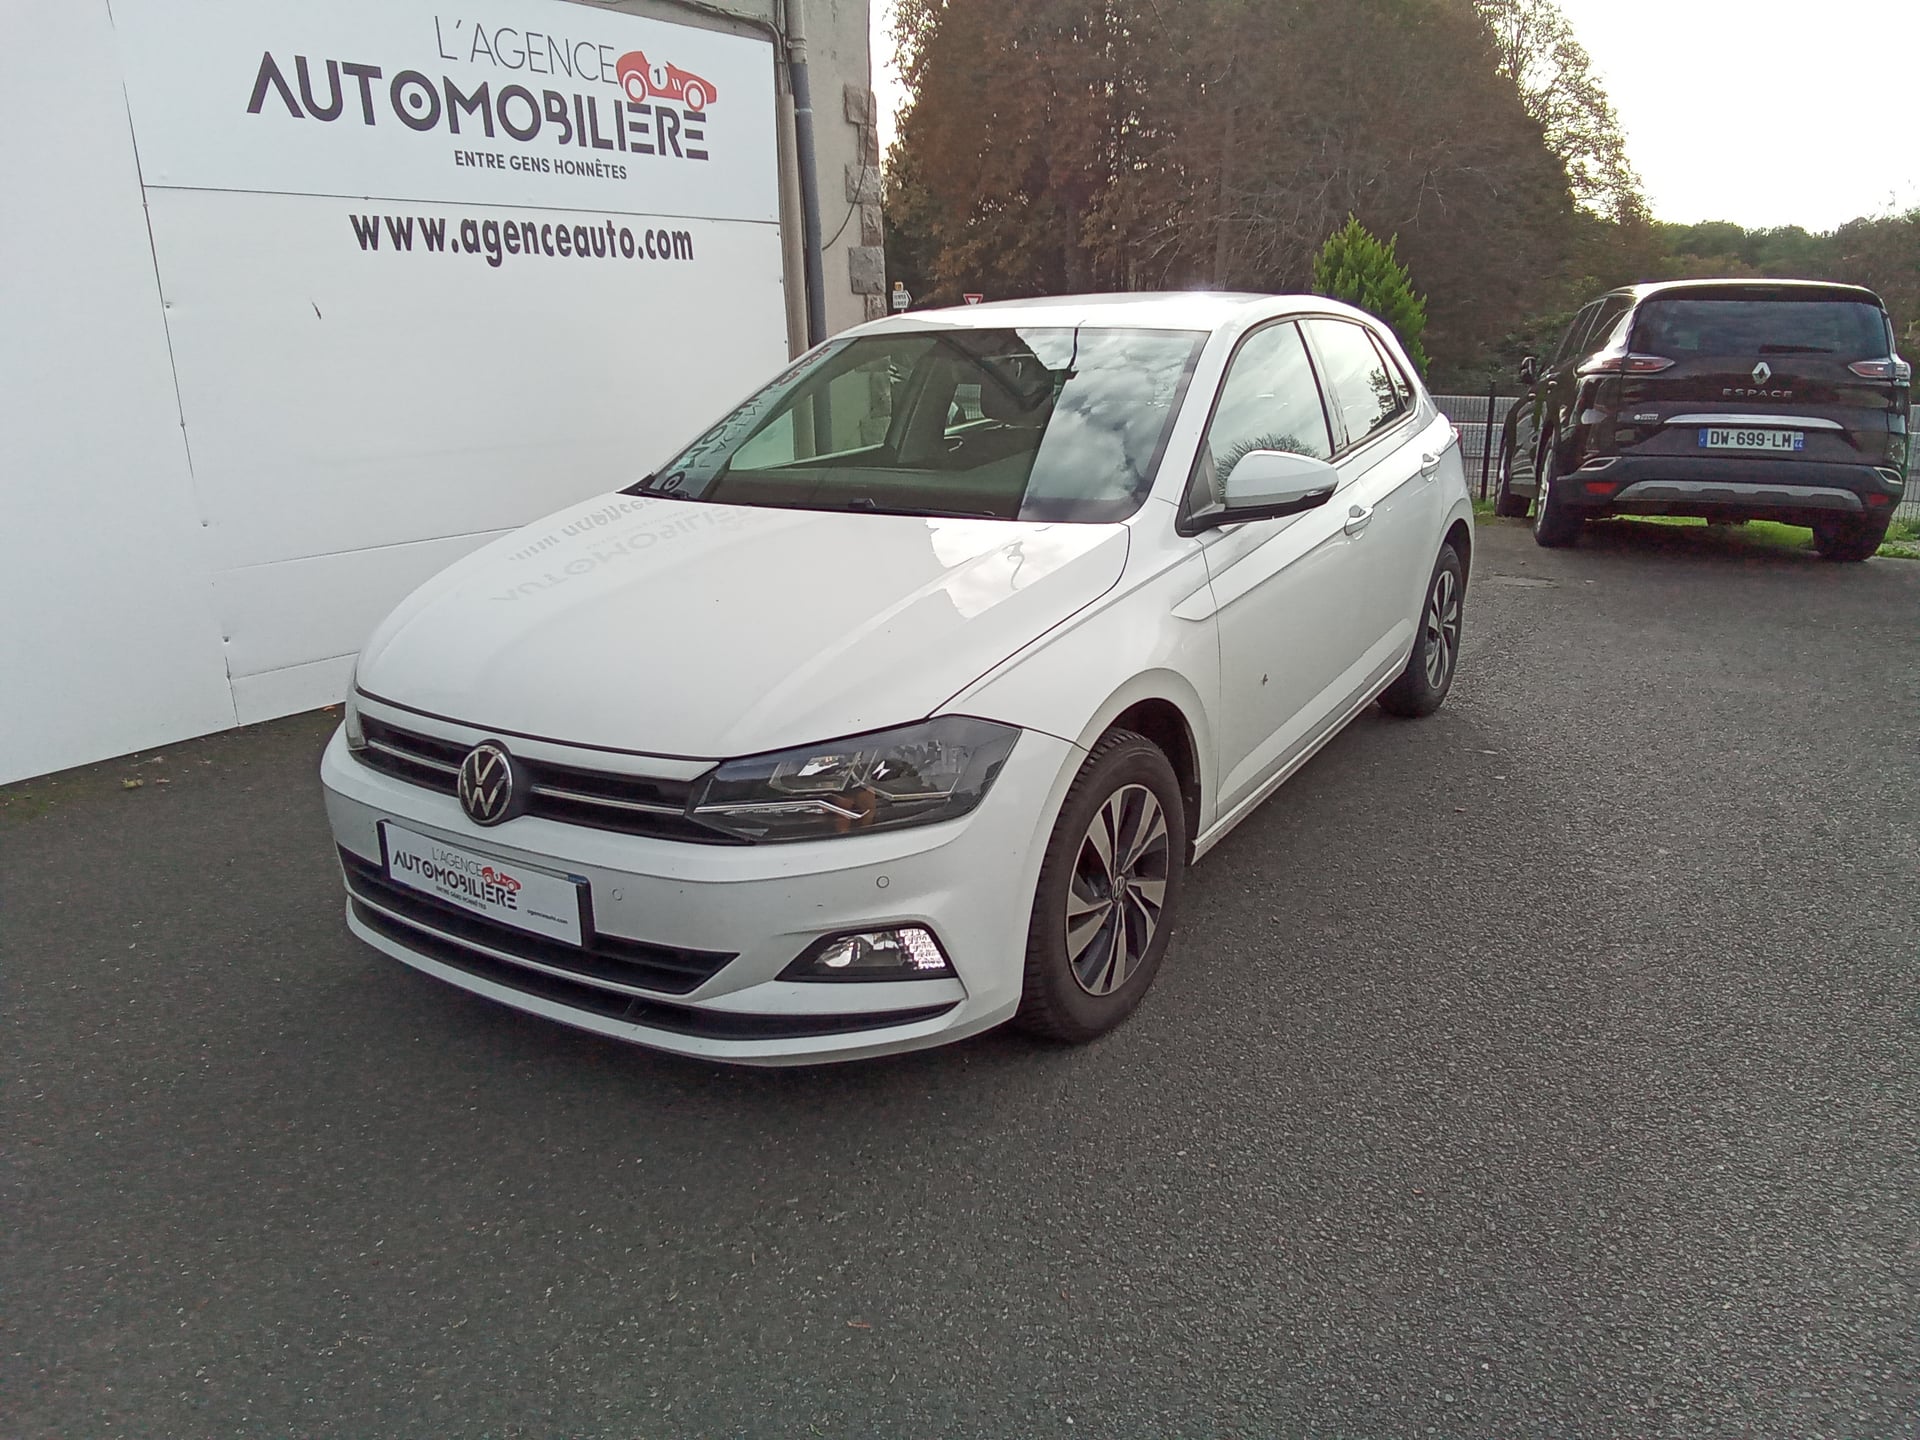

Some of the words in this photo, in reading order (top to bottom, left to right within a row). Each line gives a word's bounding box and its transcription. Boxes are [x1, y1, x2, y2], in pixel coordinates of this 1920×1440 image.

[433, 15, 619, 85] L'AGENCE
[246, 51, 709, 161] AUTOMOBILIERE
[454, 149, 506, 170] ENTRE
[509, 155, 551, 173] GENS
[553, 158, 627, 180] HONNÊTES
[349, 214, 694, 268] www.agenceauto.com
[1722, 388, 1794, 398] ESPACE
[1710, 430, 1792, 449] DW-699-LM
[393, 849, 518, 911] AUTOMOBILIERE
[431, 847, 483, 877] L'AGENCE
